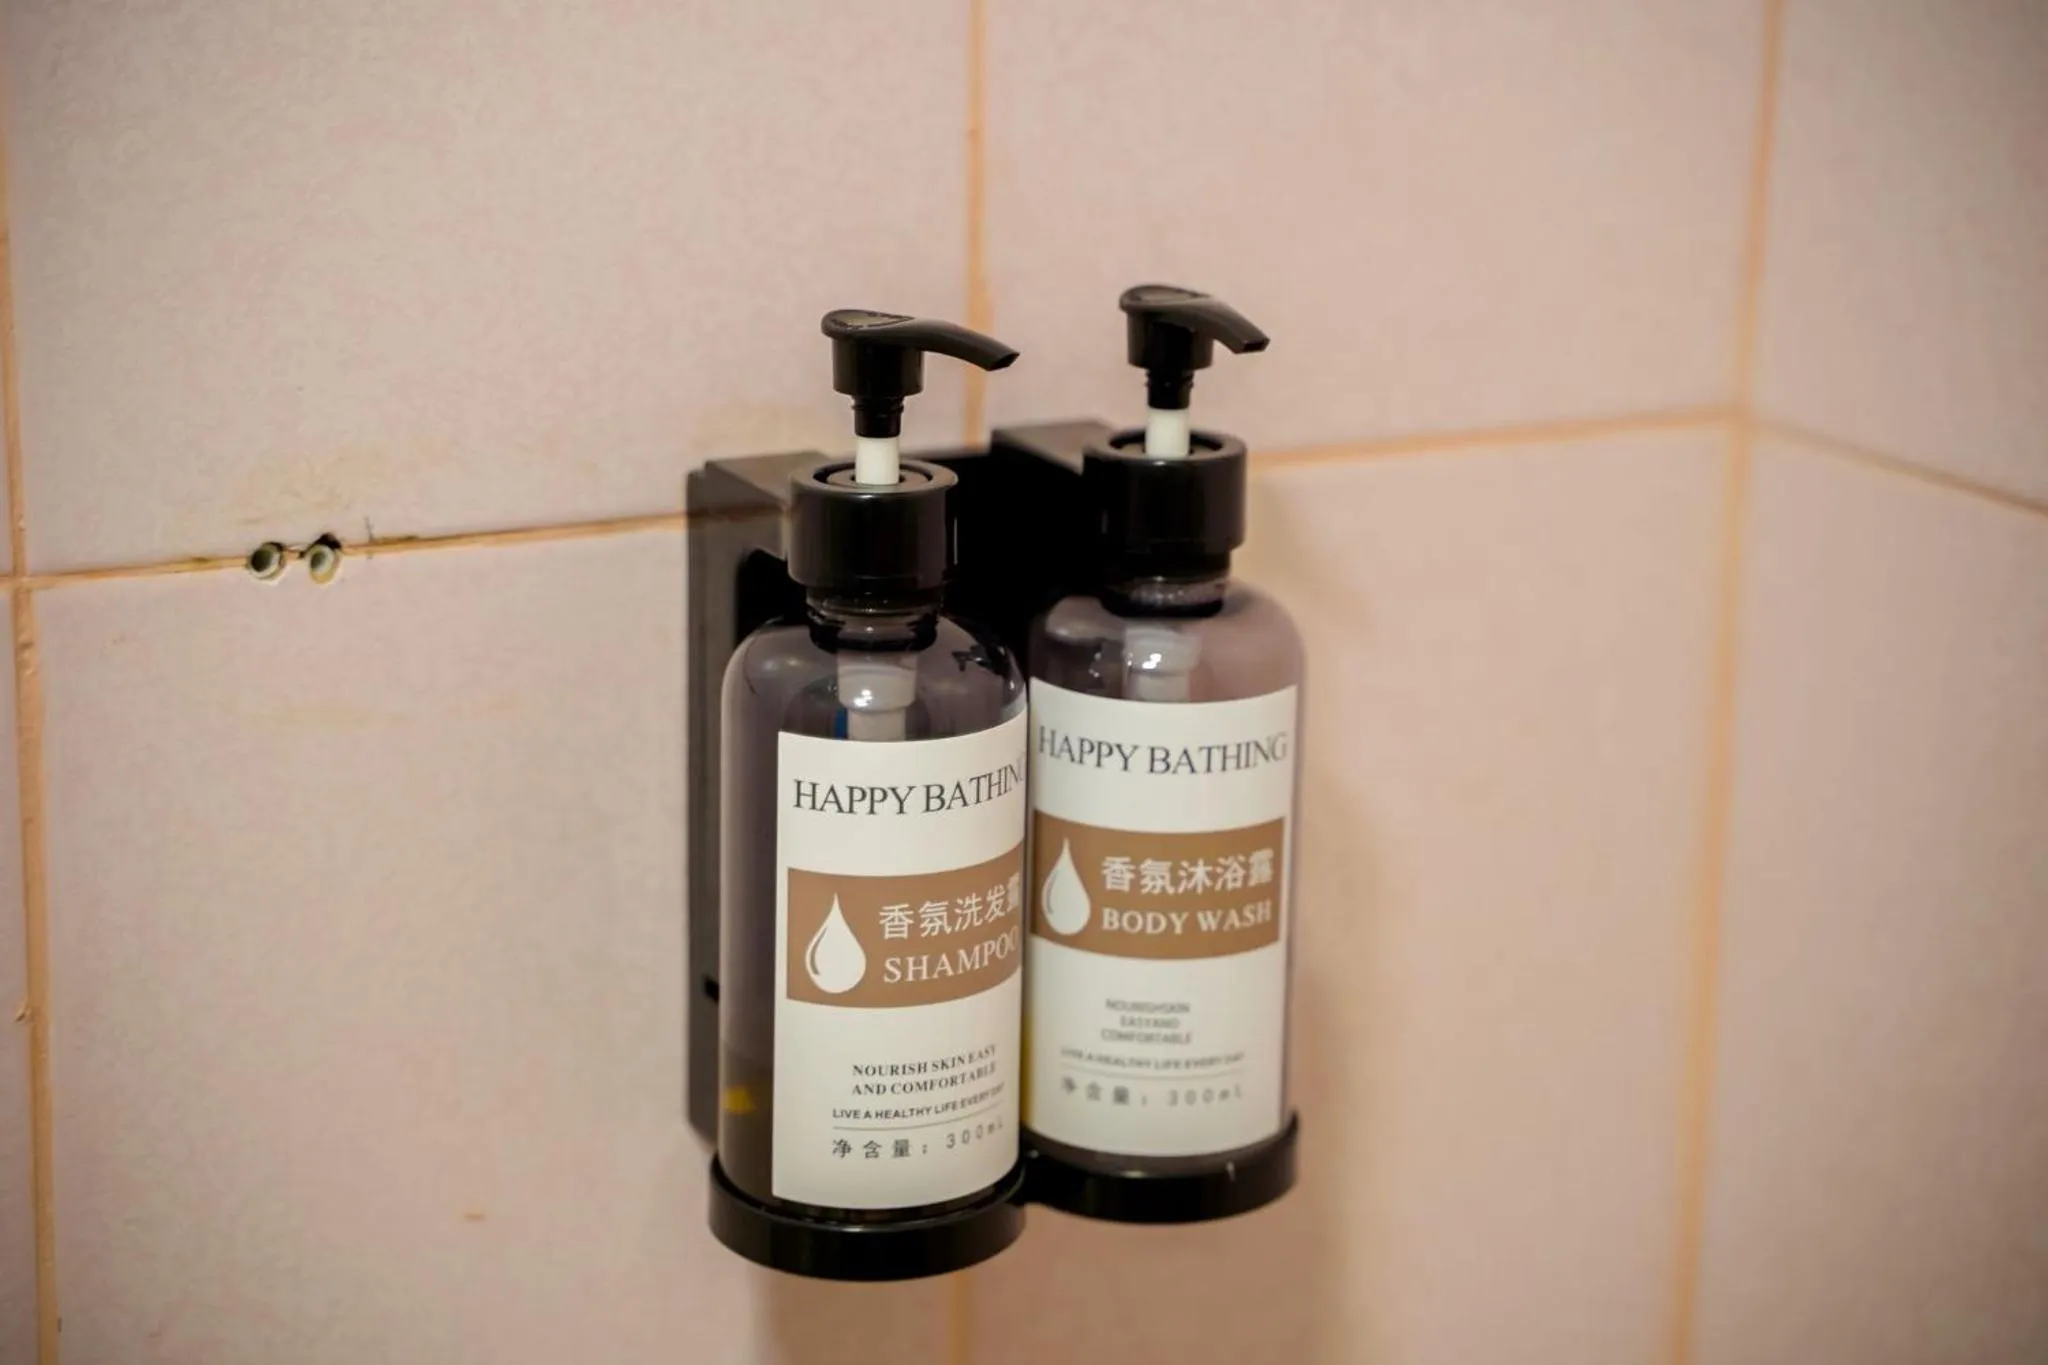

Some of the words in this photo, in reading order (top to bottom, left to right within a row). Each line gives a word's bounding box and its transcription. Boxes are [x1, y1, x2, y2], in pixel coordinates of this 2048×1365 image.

[1039, 725, 1138, 772] HAPPY
[1148, 731, 1288, 774] BATHING
[794, 778, 916, 815] HAPPY
[1102, 848, 1274, 894] 香氛沐浴露
[1102, 907, 1189, 935] BODY
[1198, 898, 1273, 931] WASH
[852, 1062, 928, 1077] NOURISH
[932, 1056, 965, 1072] SKIN
[968, 1044, 996, 1064] EASY
[852, 1083, 887, 1096] AND
[891, 1061, 996, 1095] COMFORTABLE
[832, 1108, 863, 1119] LIVE
[863, 1109, 873, 1119] A
[875, 1106, 932, 1119] HEALTHY
[935, 1100, 958, 1115] LIFE
